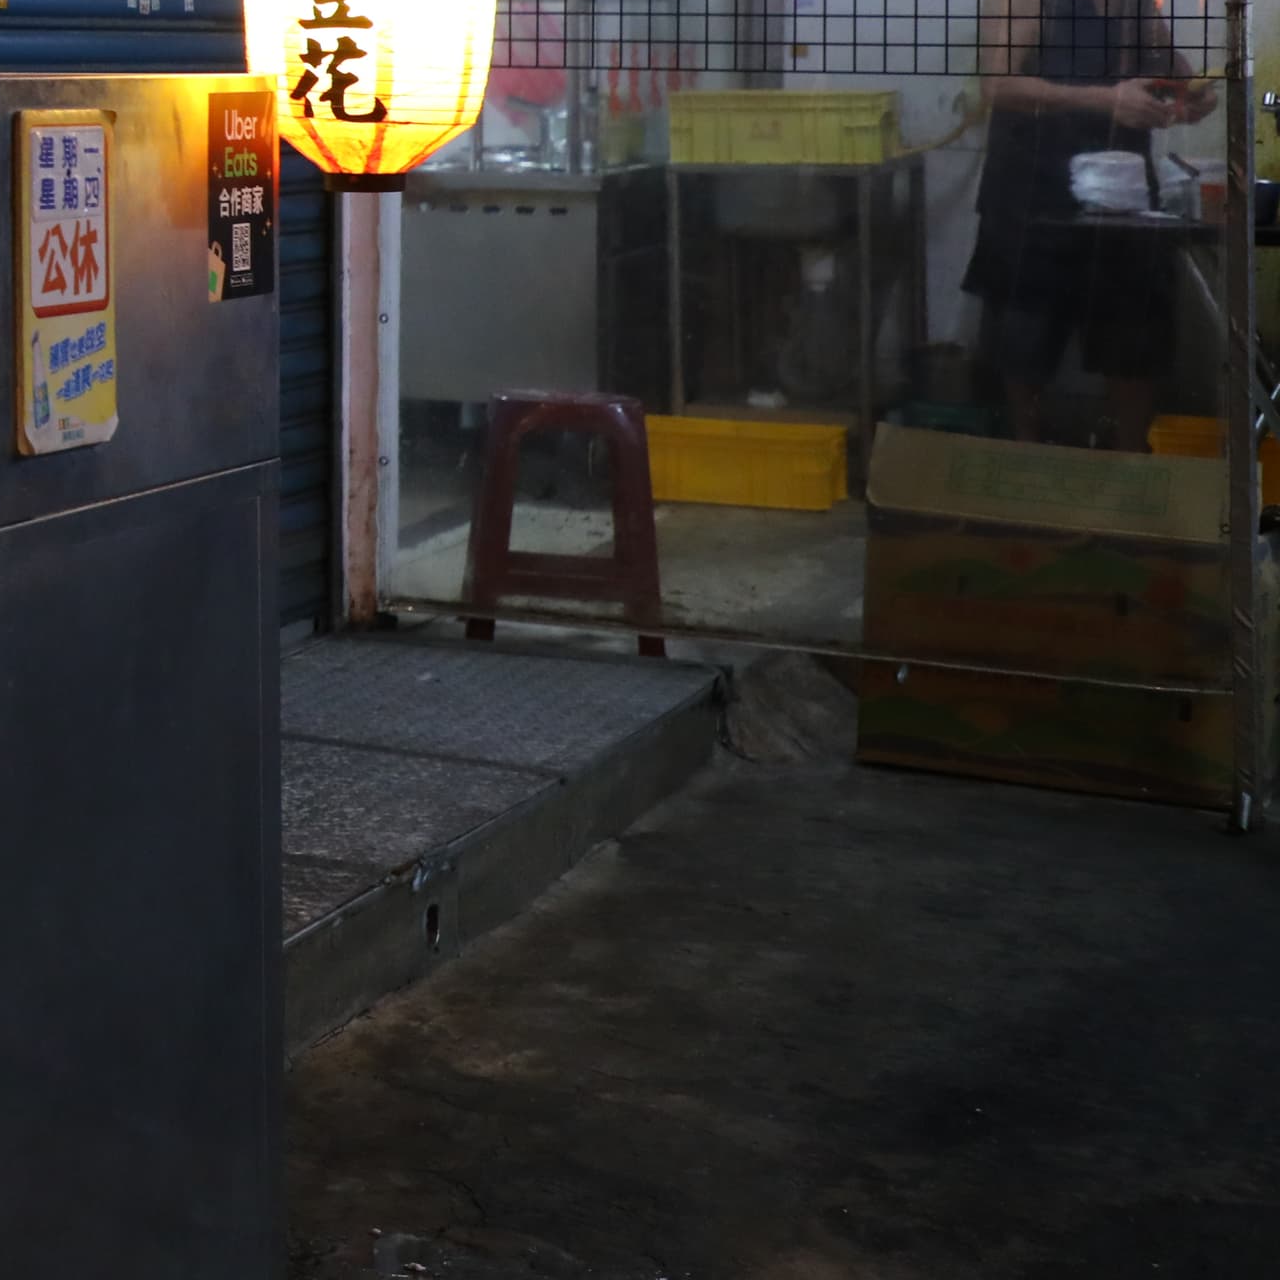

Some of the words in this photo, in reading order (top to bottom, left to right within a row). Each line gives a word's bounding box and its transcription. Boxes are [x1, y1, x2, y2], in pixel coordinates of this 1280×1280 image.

[224, 109, 258, 141] Uber
[224, 147, 258, 178] Eats
[218, 184, 264, 218] 合作商家
[39, 219, 100, 297] 公休
